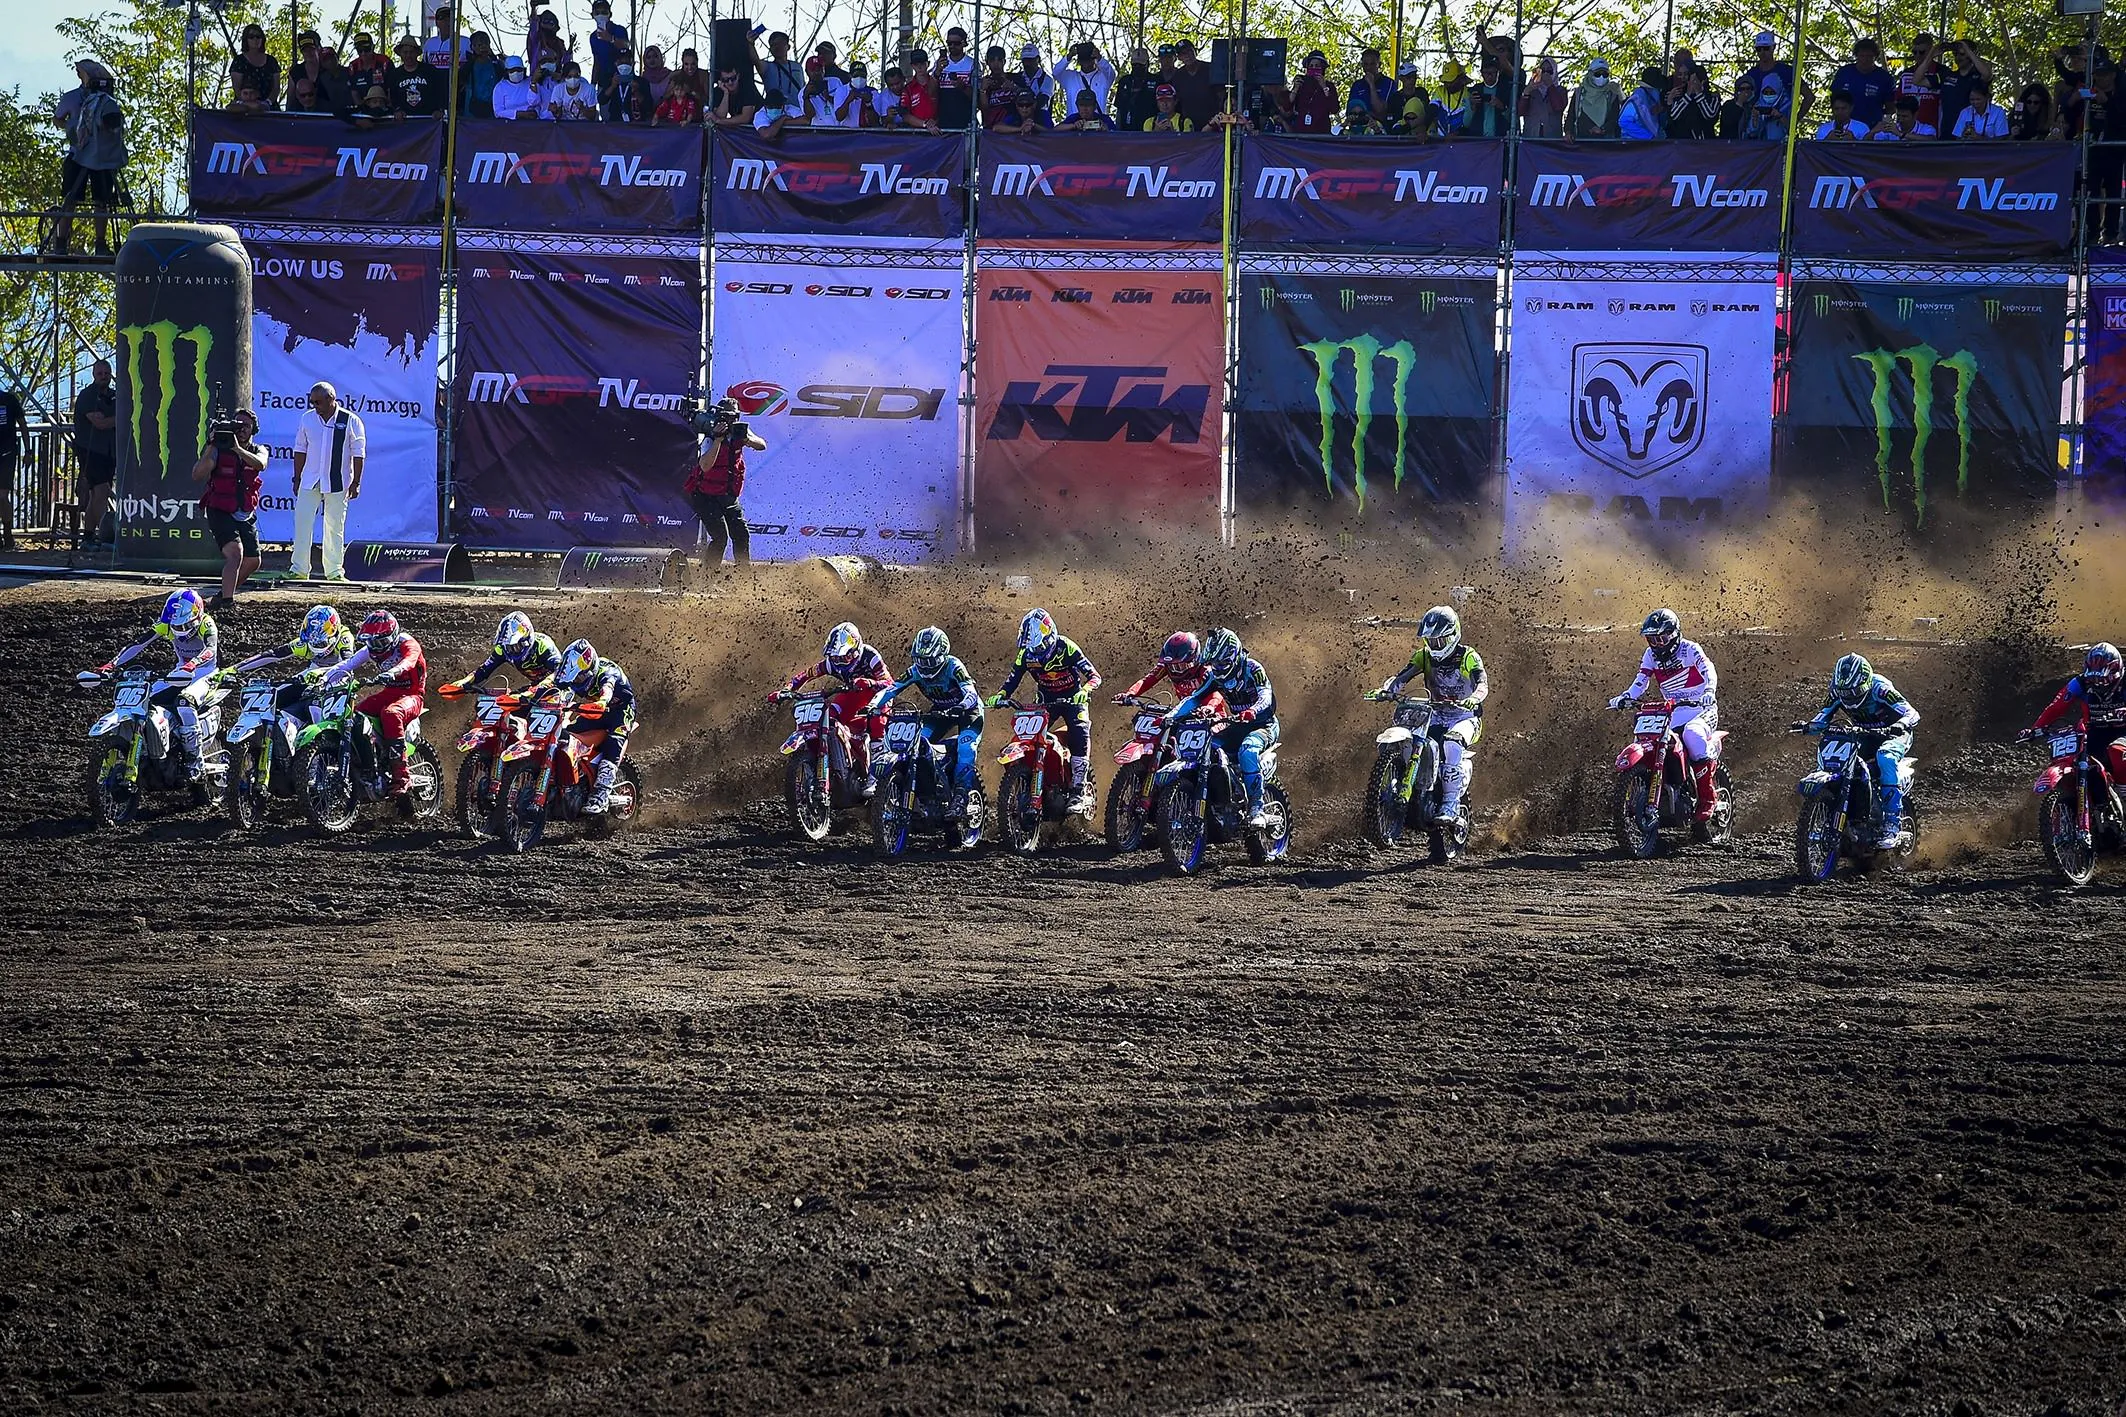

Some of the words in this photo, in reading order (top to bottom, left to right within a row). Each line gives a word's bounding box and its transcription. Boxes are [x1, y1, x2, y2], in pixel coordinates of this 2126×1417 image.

[253, 257, 305, 278] LOW
[311, 260, 344, 279] US
[989, 286, 1032, 302] KTM
[1051, 288, 1093, 303] KTM
[1112, 288, 1153, 304] KTM
[1171, 289, 1212, 304] KTM
[1276, 292, 1313, 300] MONSTER
[1357, 294, 1394, 302] MONSTER
[1437, 296, 1475, 304] MONSTER
[1547, 302, 1594, 310] RAM
[1629, 303, 1675, 311] RAM
[1712, 304, 1760, 312] RAM
[260, 391, 421, 418] Faceok/mxgp
[986, 365, 1211, 444] KTM
[121, 528, 202, 539] ENERG
[384, 549, 430, 557] MONSTER
[116, 688, 145, 706] 96
[243, 693, 273, 711] 74
[323, 695, 347, 719] 24
[477, 702, 504, 720] 72
[794, 703, 824, 725] 516
[528, 713, 557, 733] 79
[888, 722, 917, 741] 198
[1014, 716, 1044, 735] 80
[1634, 715, 1668, 734] 122
[1180, 730, 1206, 750] 93
[2052, 737, 2077, 757] 125
[1822, 741, 1851, 761] 44
